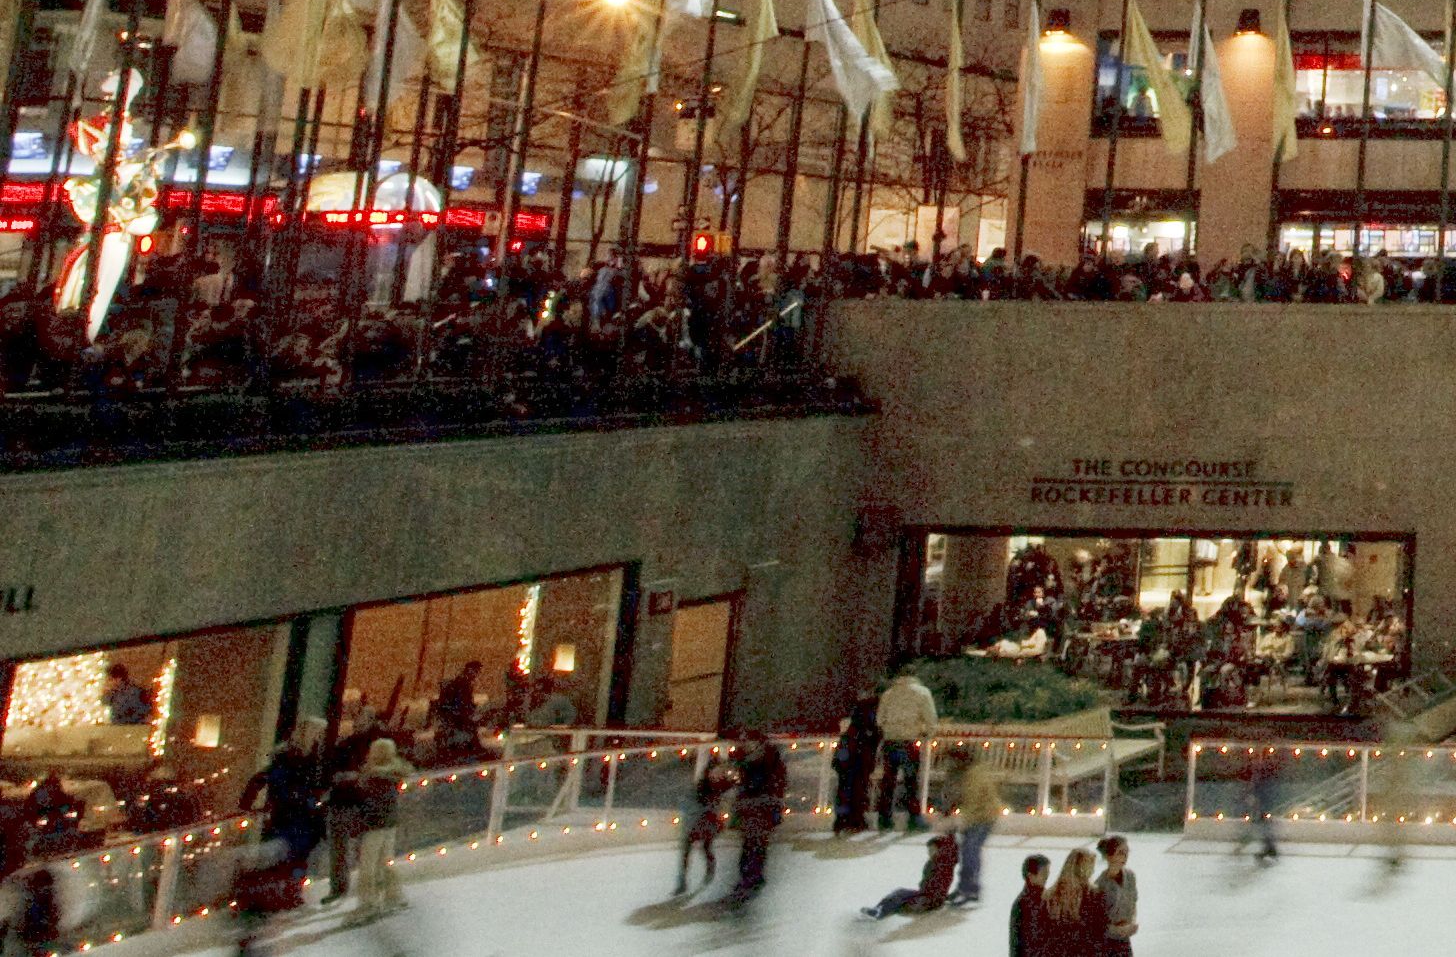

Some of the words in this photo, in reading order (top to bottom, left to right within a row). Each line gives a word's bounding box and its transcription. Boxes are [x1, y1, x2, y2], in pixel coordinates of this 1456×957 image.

[1072, 458, 1113, 476] THE
[1119, 459, 1259, 478] CONCOURSE
[1031, 486, 1193, 505] ROCKEFELLER
[1201, 488, 1294, 506] CENTER
